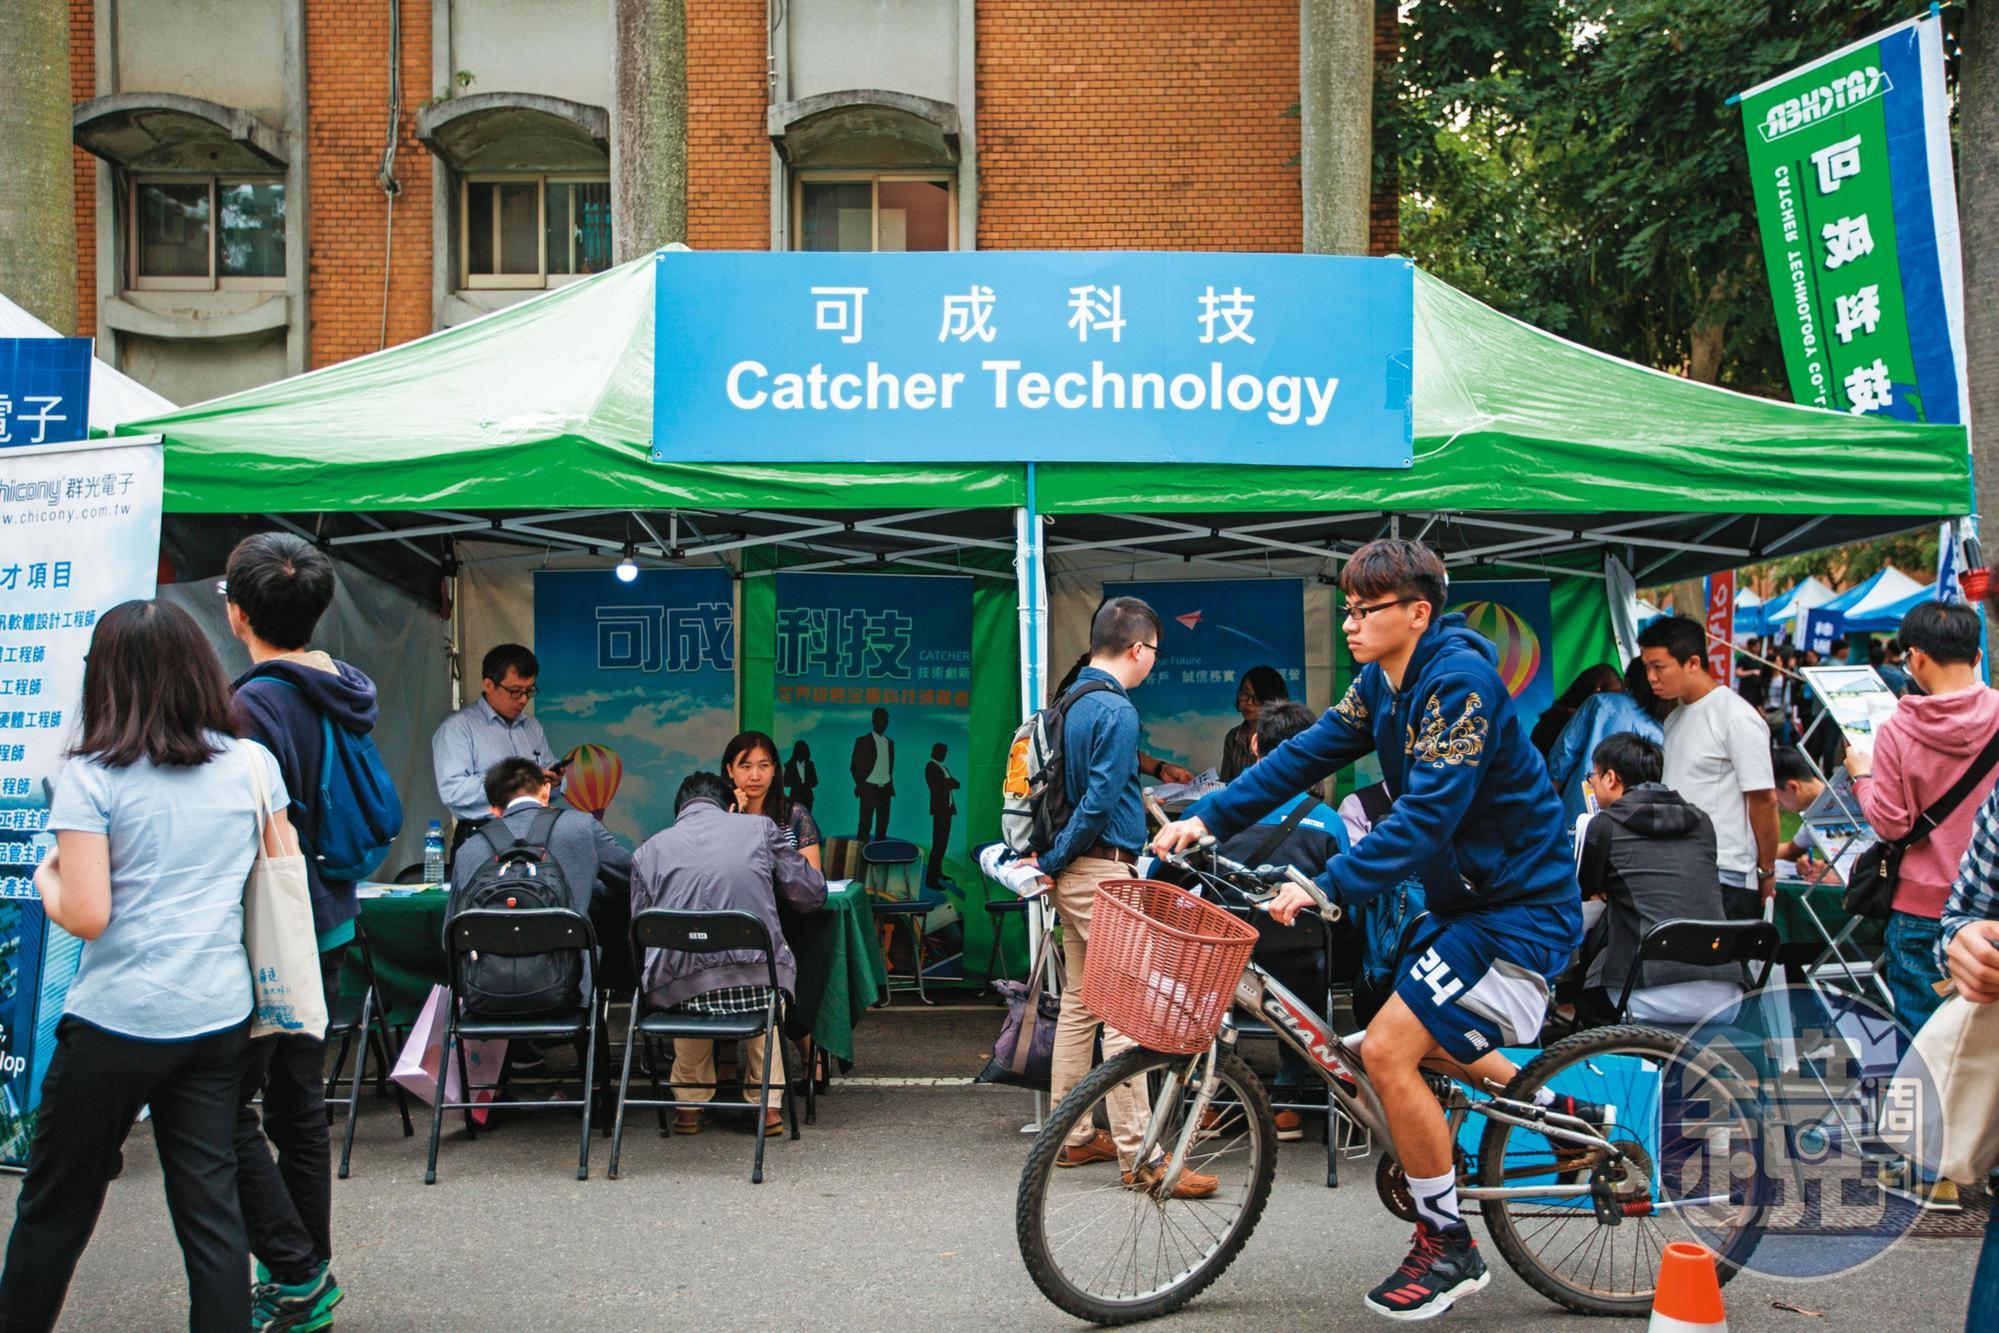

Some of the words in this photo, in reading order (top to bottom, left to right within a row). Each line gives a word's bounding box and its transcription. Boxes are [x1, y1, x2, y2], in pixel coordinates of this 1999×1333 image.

[810, 285, 1258, 345] 可成科技
[725, 360, 965, 410] Catcher
[982, 360, 1340, 427] Technology
[66, 472, 134, 499] 群光電子
[0, 561, 72, 590] 才項目
[595, 602, 735, 672] 可成
[775, 607, 913, 679] 科技
[919, 650, 970, 661] CATCHER
[1410, 946, 1465, 1007] 24
[1264, 999, 1354, 1078] GIANT
